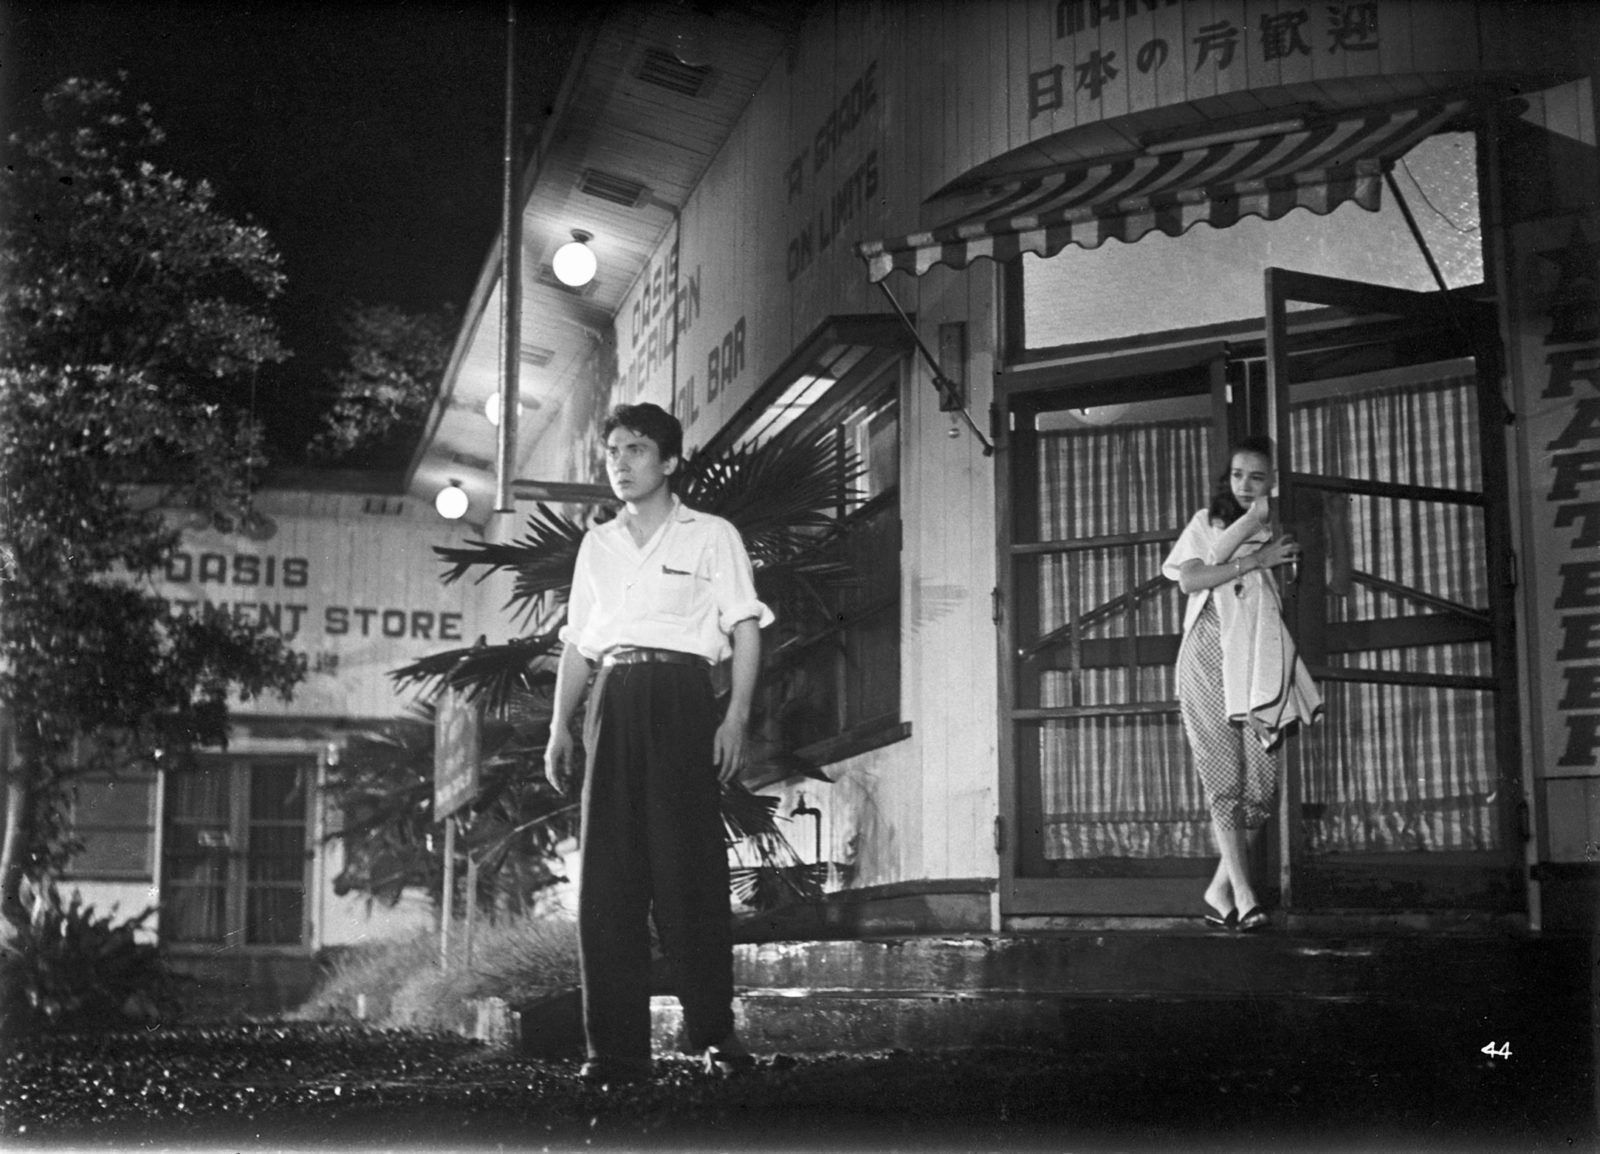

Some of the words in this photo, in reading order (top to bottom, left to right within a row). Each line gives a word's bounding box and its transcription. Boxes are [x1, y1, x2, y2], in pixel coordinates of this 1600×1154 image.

[814, 60, 877, 174] GRADE
[787, 222, 813, 283] ON
[819, 149, 878, 253] LIMITS
[632, 241, 677, 349] OASIS
[707, 315, 746, 403] BAR
[165, 553, 309, 587] OASIS
[324, 606, 464, 641] STORE
